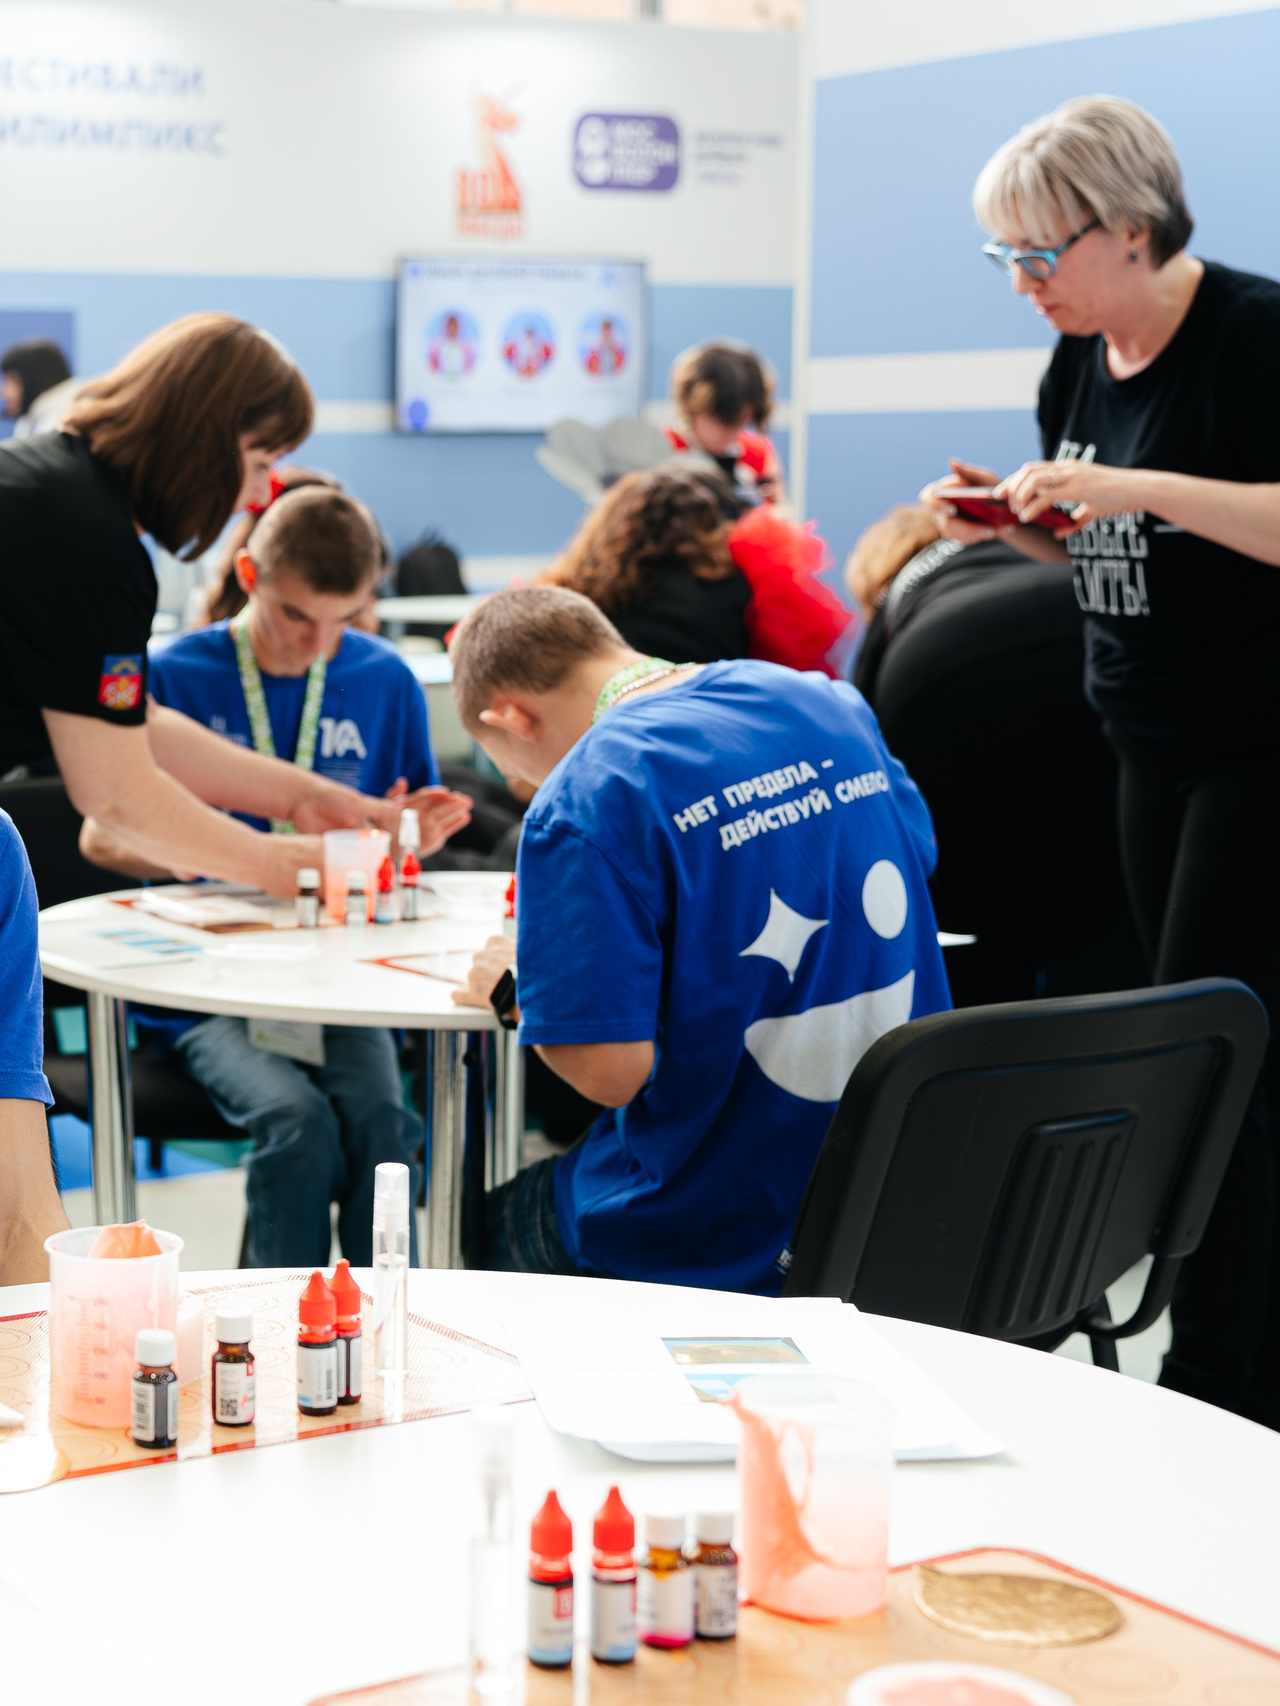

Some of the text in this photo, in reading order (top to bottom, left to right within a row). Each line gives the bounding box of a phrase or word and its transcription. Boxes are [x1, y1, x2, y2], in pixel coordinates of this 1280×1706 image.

[673, 795, 718, 833] НЕТ
[722, 760, 818, 808] ПРЕДЕЛА
[719, 769, 890, 851] ДЕЙСТВУЙ СМЕЛО
